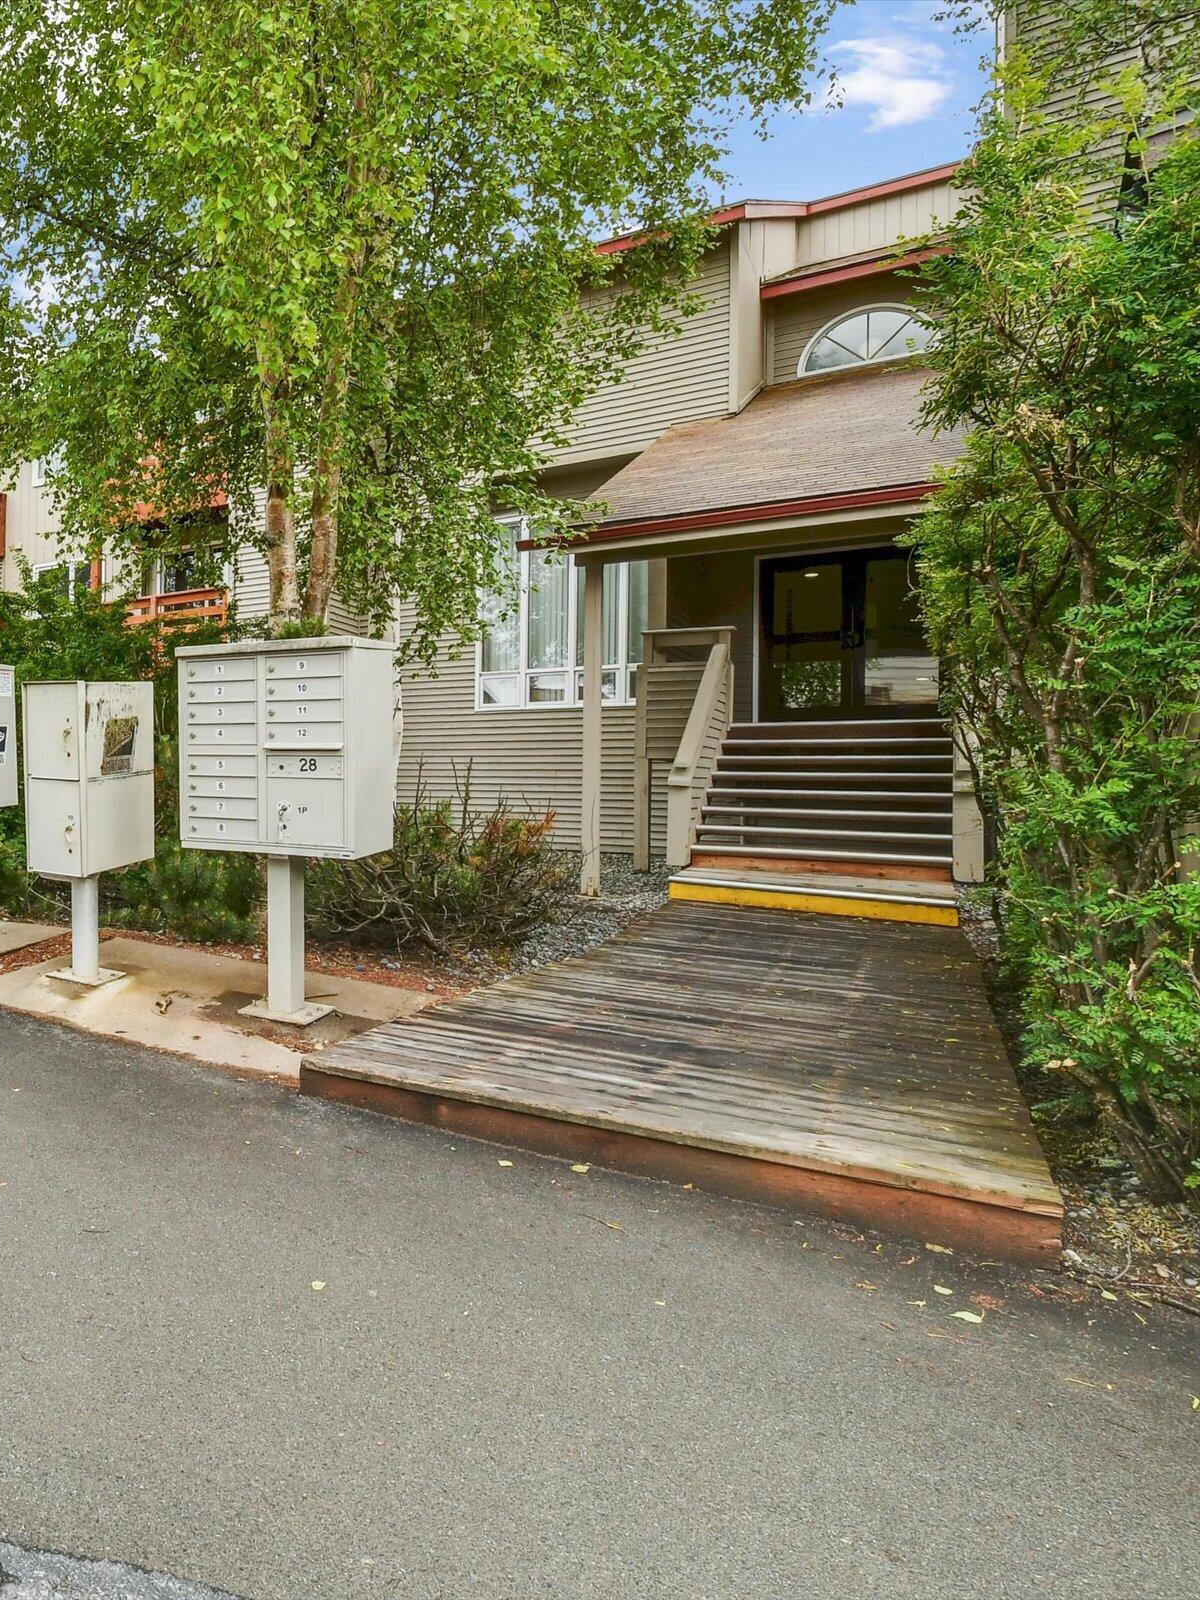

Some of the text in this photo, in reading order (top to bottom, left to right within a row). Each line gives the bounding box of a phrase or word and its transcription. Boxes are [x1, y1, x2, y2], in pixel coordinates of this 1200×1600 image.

[299, 661, 305, 670] 9
[217, 687, 223, 695] 2
[297, 684, 307, 692] 10
[217, 708, 223, 716] 3
[297, 706, 307, 714] 11
[297, 729, 307, 737] 12
[218, 760, 224, 768] 5
[299, 757, 318, 772] 28
[218, 782, 224, 790] 6
[218, 803, 224, 811] 7
[297, 806, 308, 814] 1P
[218, 824, 224, 832] 8
